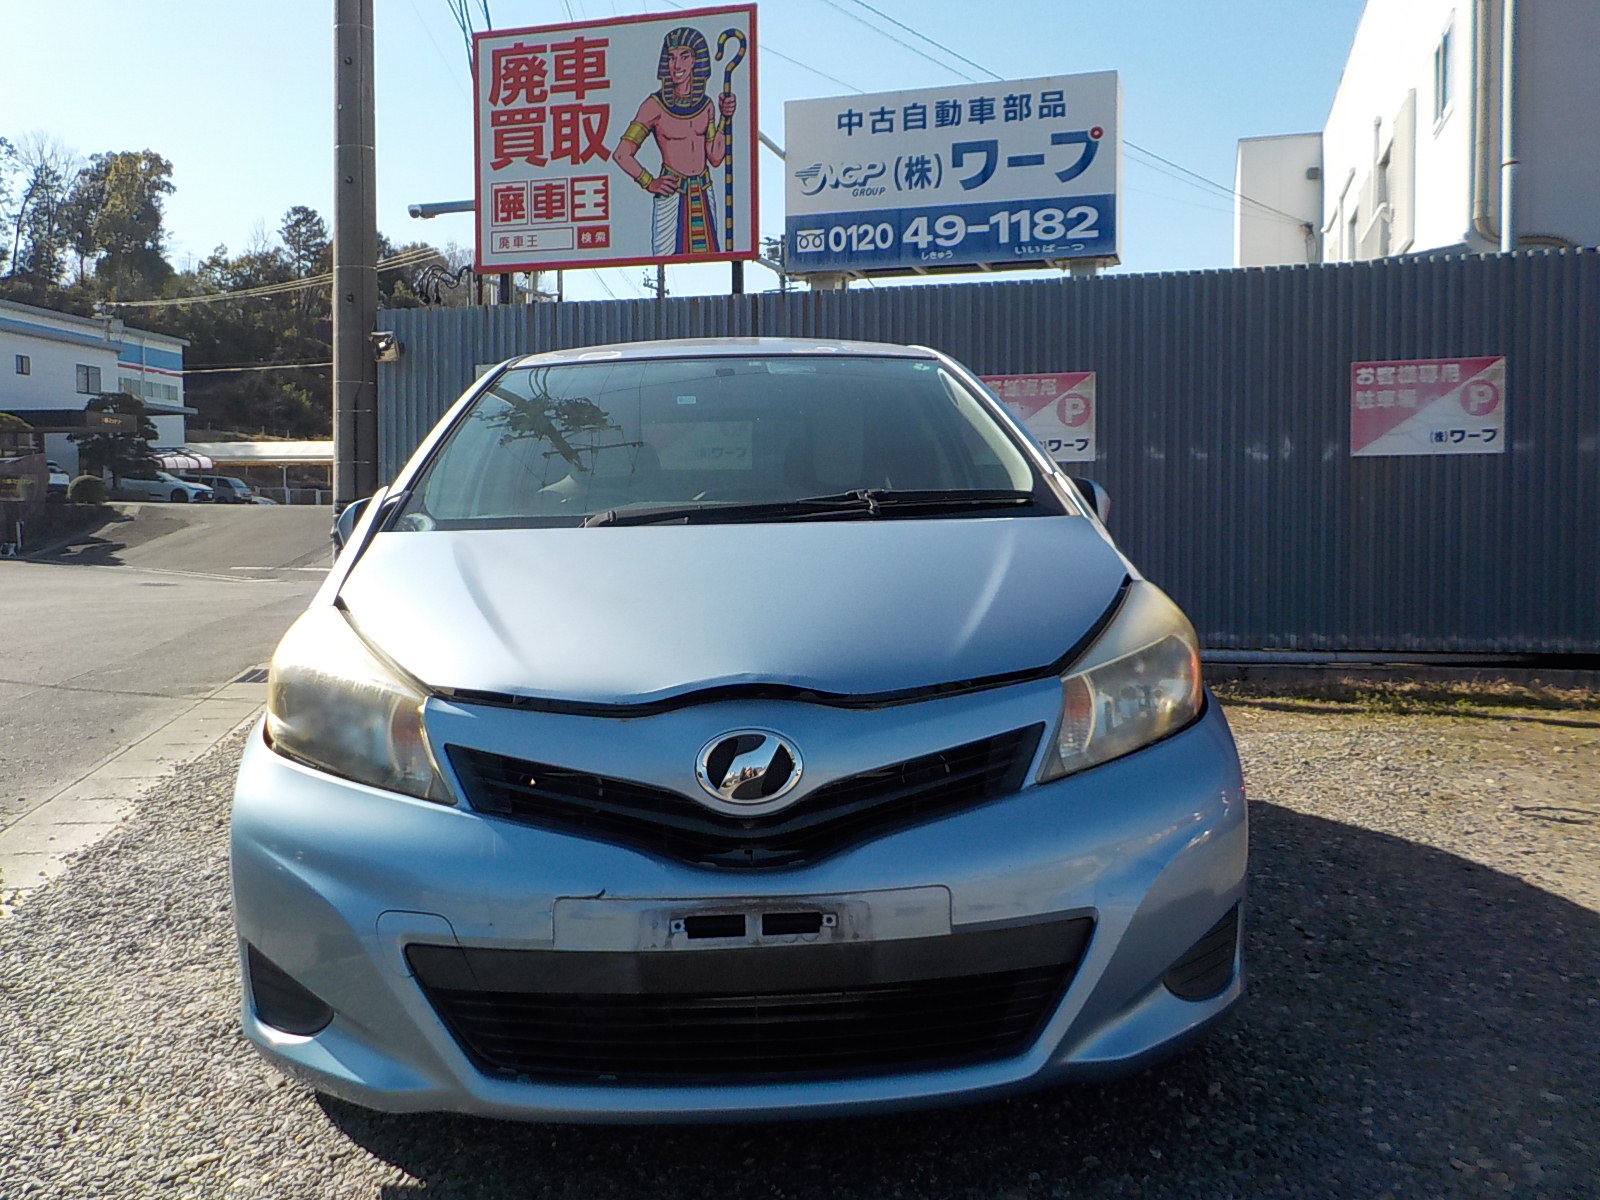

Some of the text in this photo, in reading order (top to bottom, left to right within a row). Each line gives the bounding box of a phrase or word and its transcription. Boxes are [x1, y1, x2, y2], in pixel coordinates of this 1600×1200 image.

[488, 36, 611, 107] 廃車
[489, 103, 612, 171] 買取
[836, 89, 1066, 137] 中古自動車部品
[851, 186, 887, 198] GROUP
[499, 234, 539, 249] 廃車王
[828, 205, 1099, 253] 0120 49-1182
